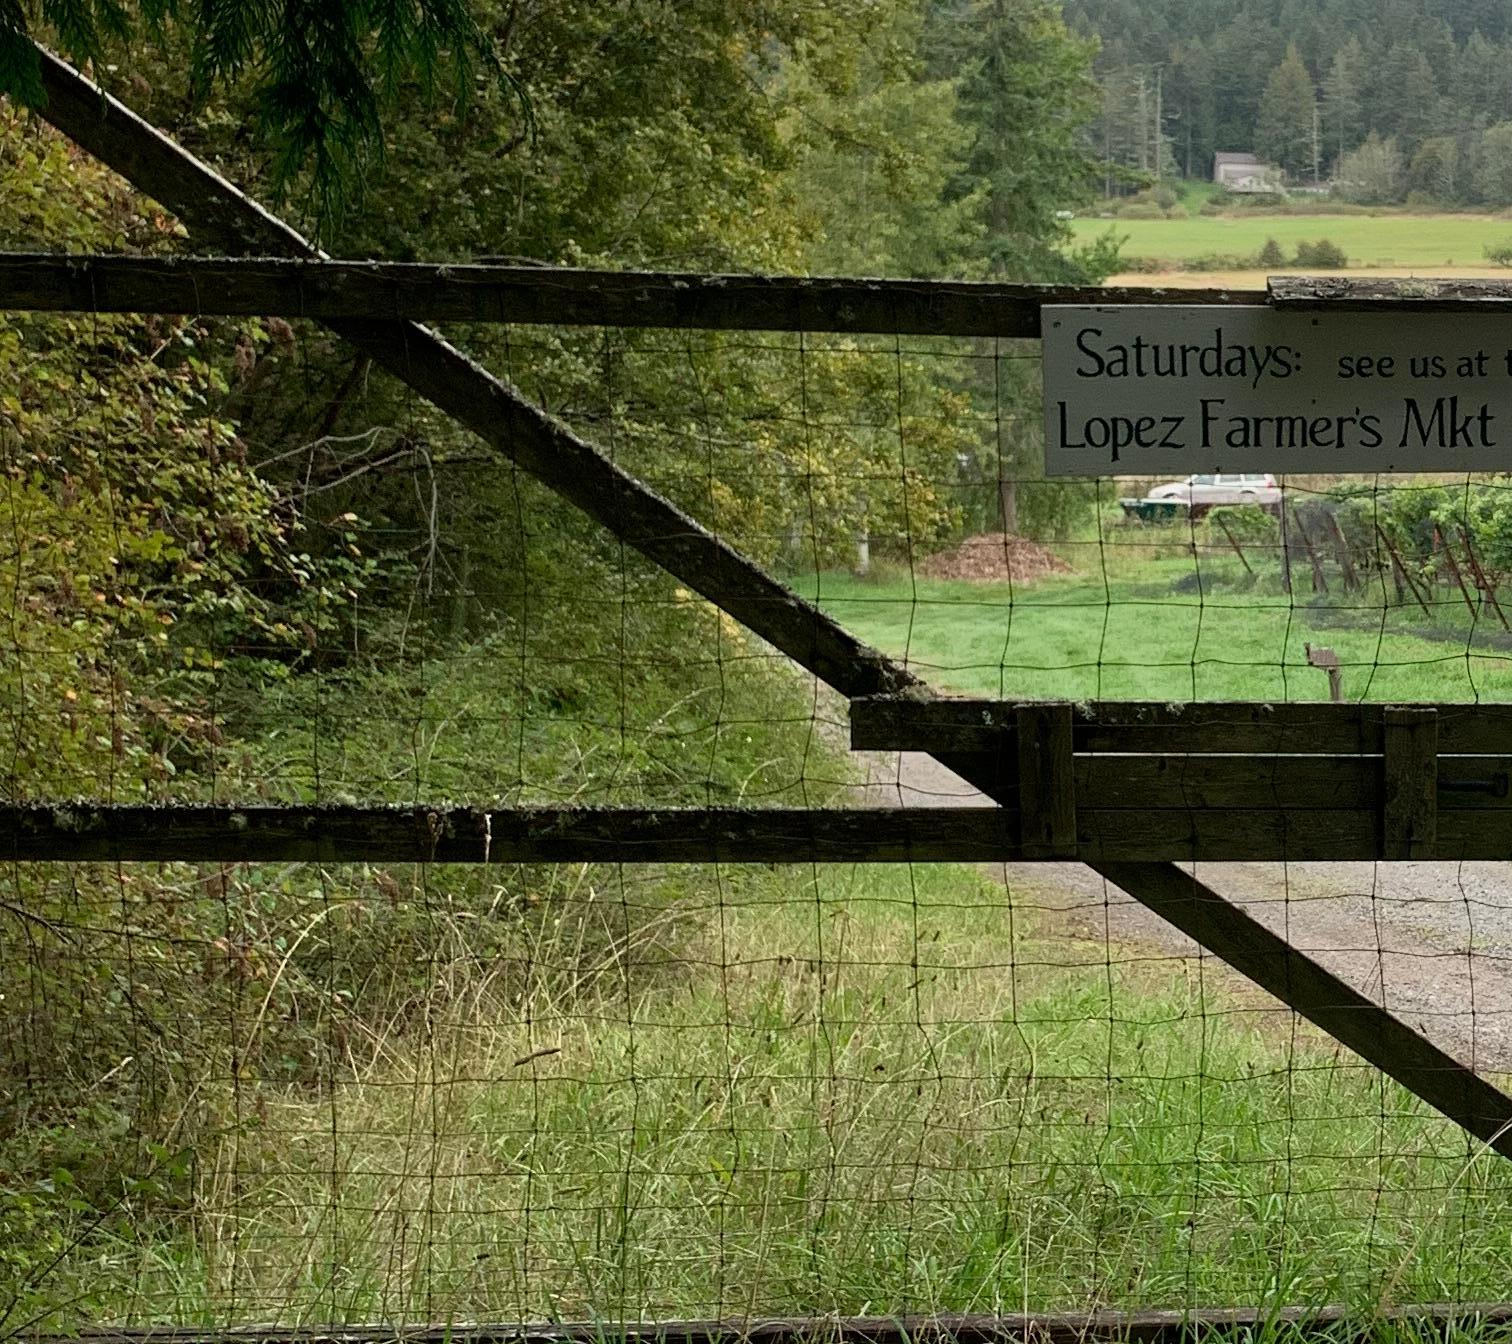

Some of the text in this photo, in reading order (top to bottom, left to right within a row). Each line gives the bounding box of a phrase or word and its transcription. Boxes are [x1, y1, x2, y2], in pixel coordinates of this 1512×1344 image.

[1075, 327, 1303, 389] Saturdays:
[1337, 353, 1396, 378] see
[1410, 353, 1448, 378] us
[1455, 348, 1489, 378] at
[1057, 401, 1185, 463] Lopez
[1199, 397, 1383, 449] Farmer's
[1398, 395, 1496, 449] Mkt
